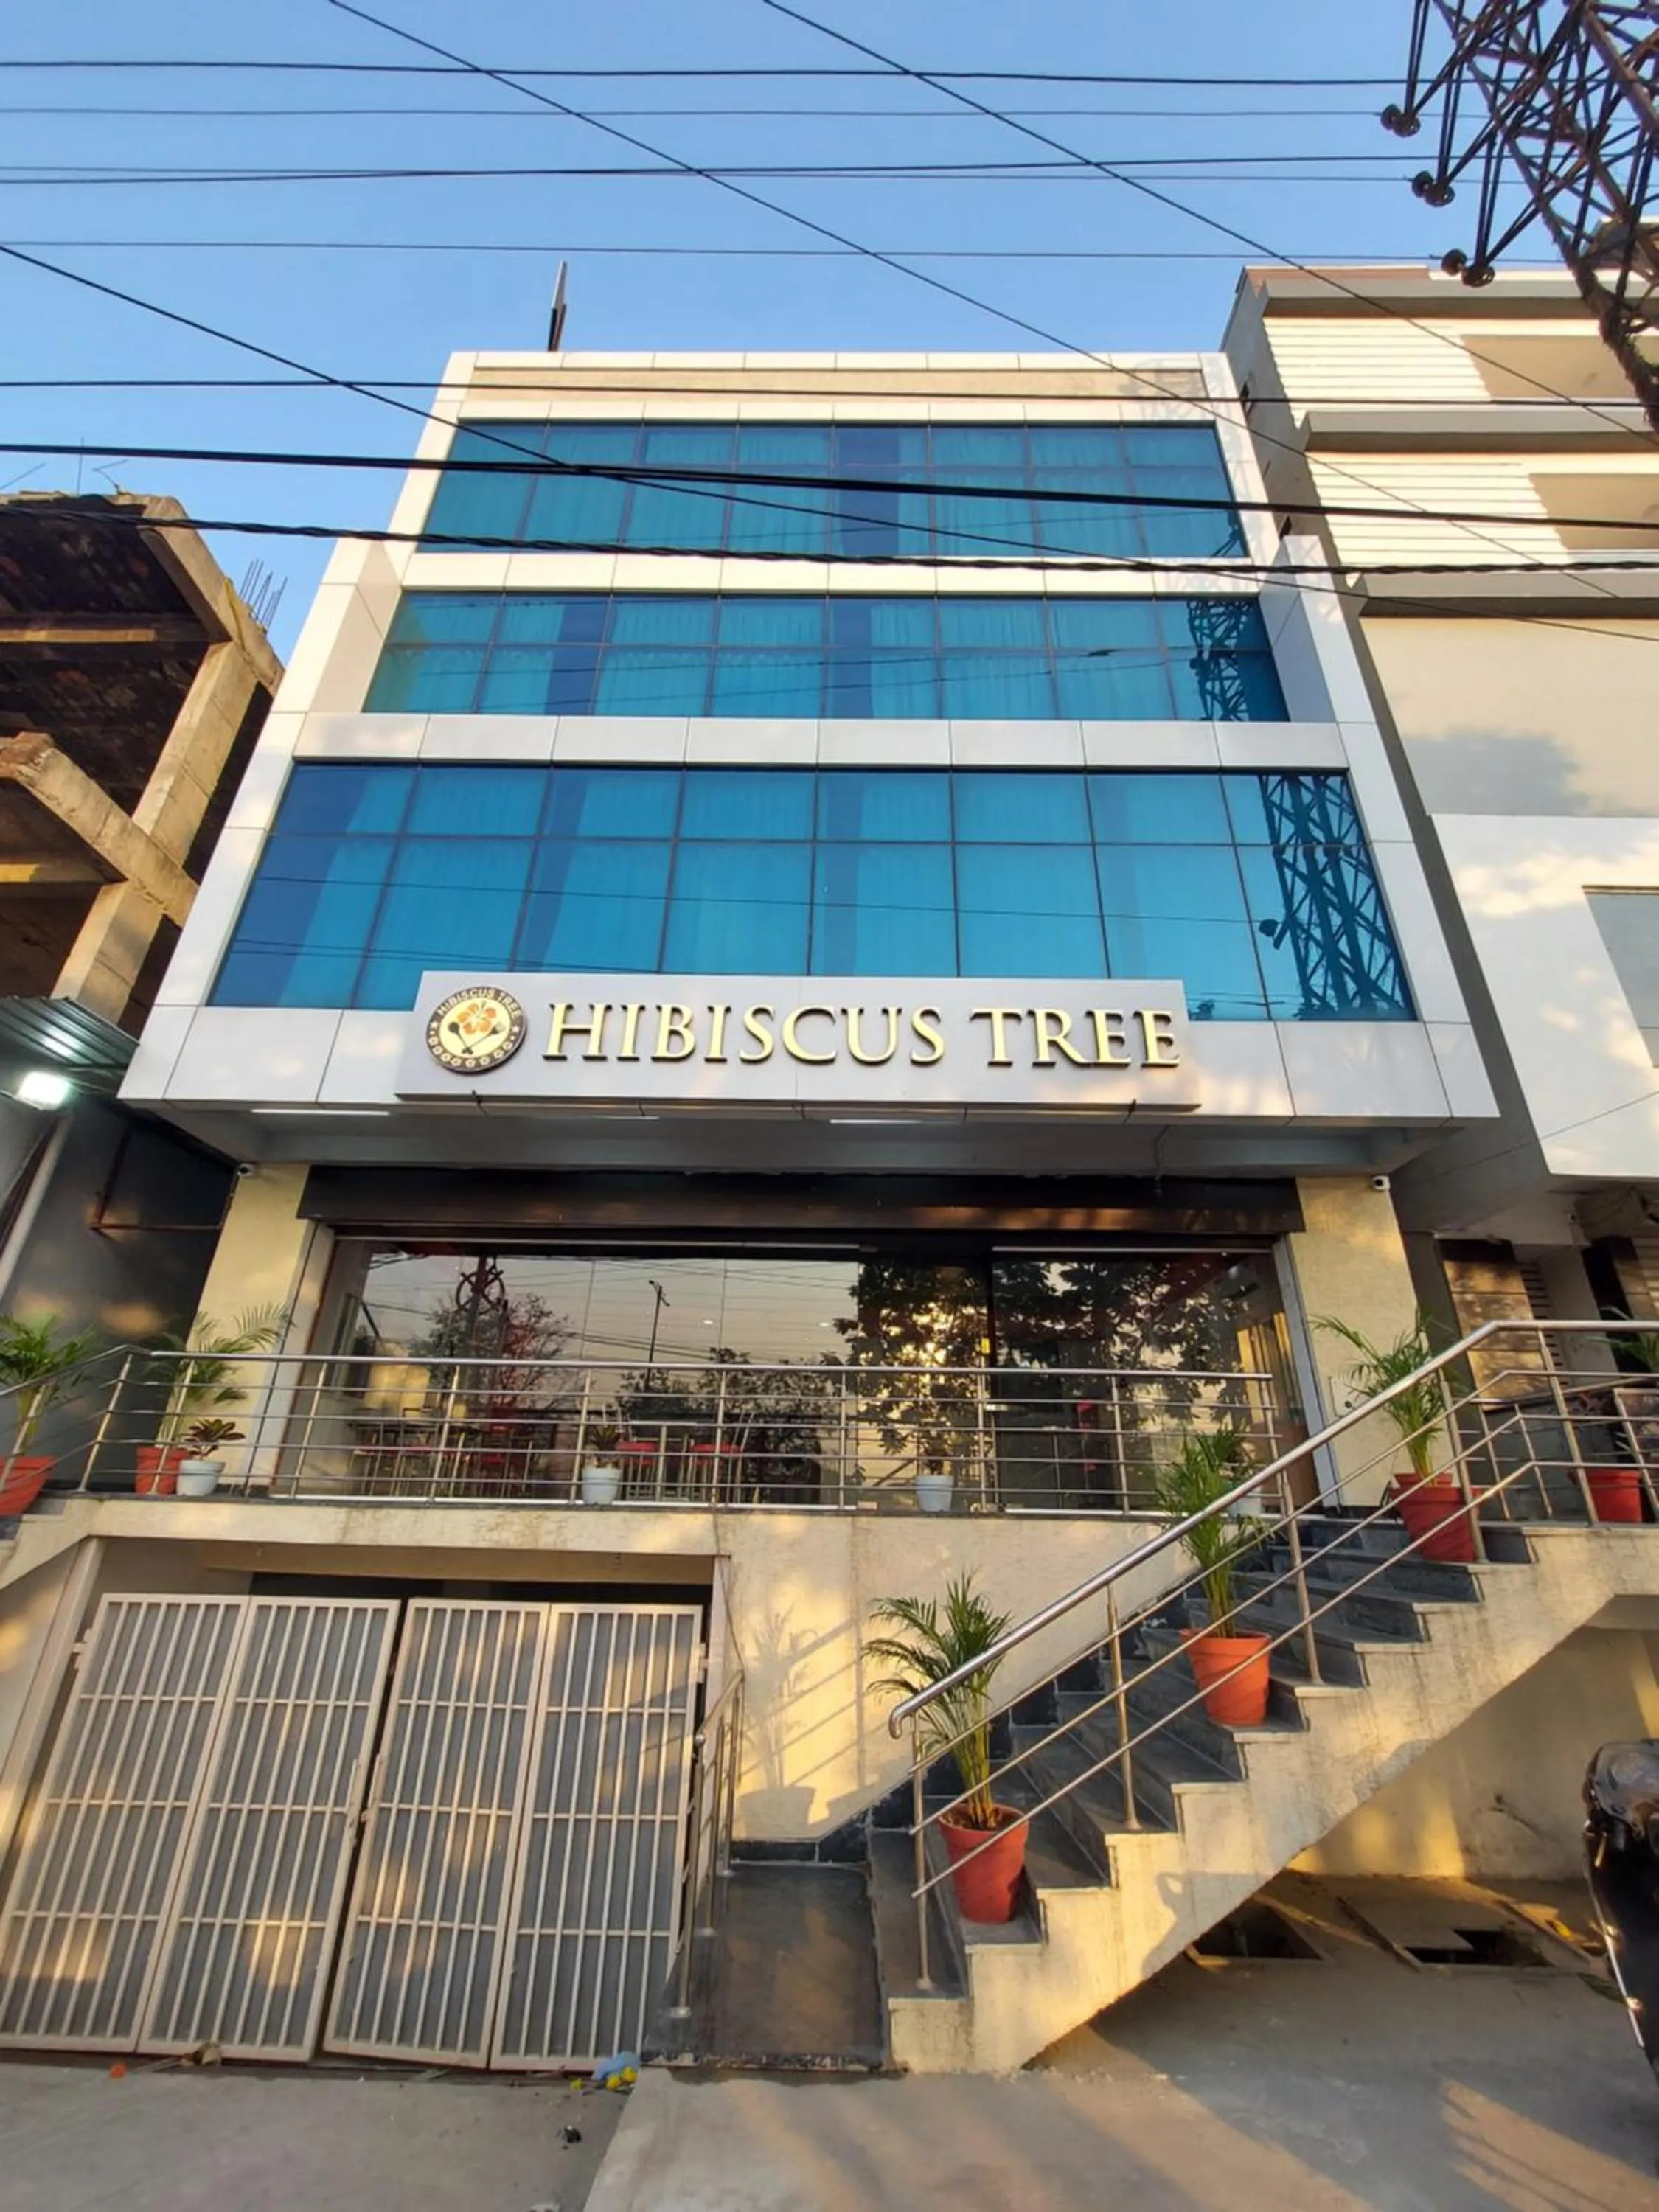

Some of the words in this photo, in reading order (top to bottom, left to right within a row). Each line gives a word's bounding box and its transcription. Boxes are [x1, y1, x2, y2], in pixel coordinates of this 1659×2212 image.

[437, 988, 495, 1015] HIBISCUS
[498, 991, 522, 1018] TREE
[542, 1003, 945, 1065] HIBISCUS
[970, 1006, 1180, 1068] TREE
